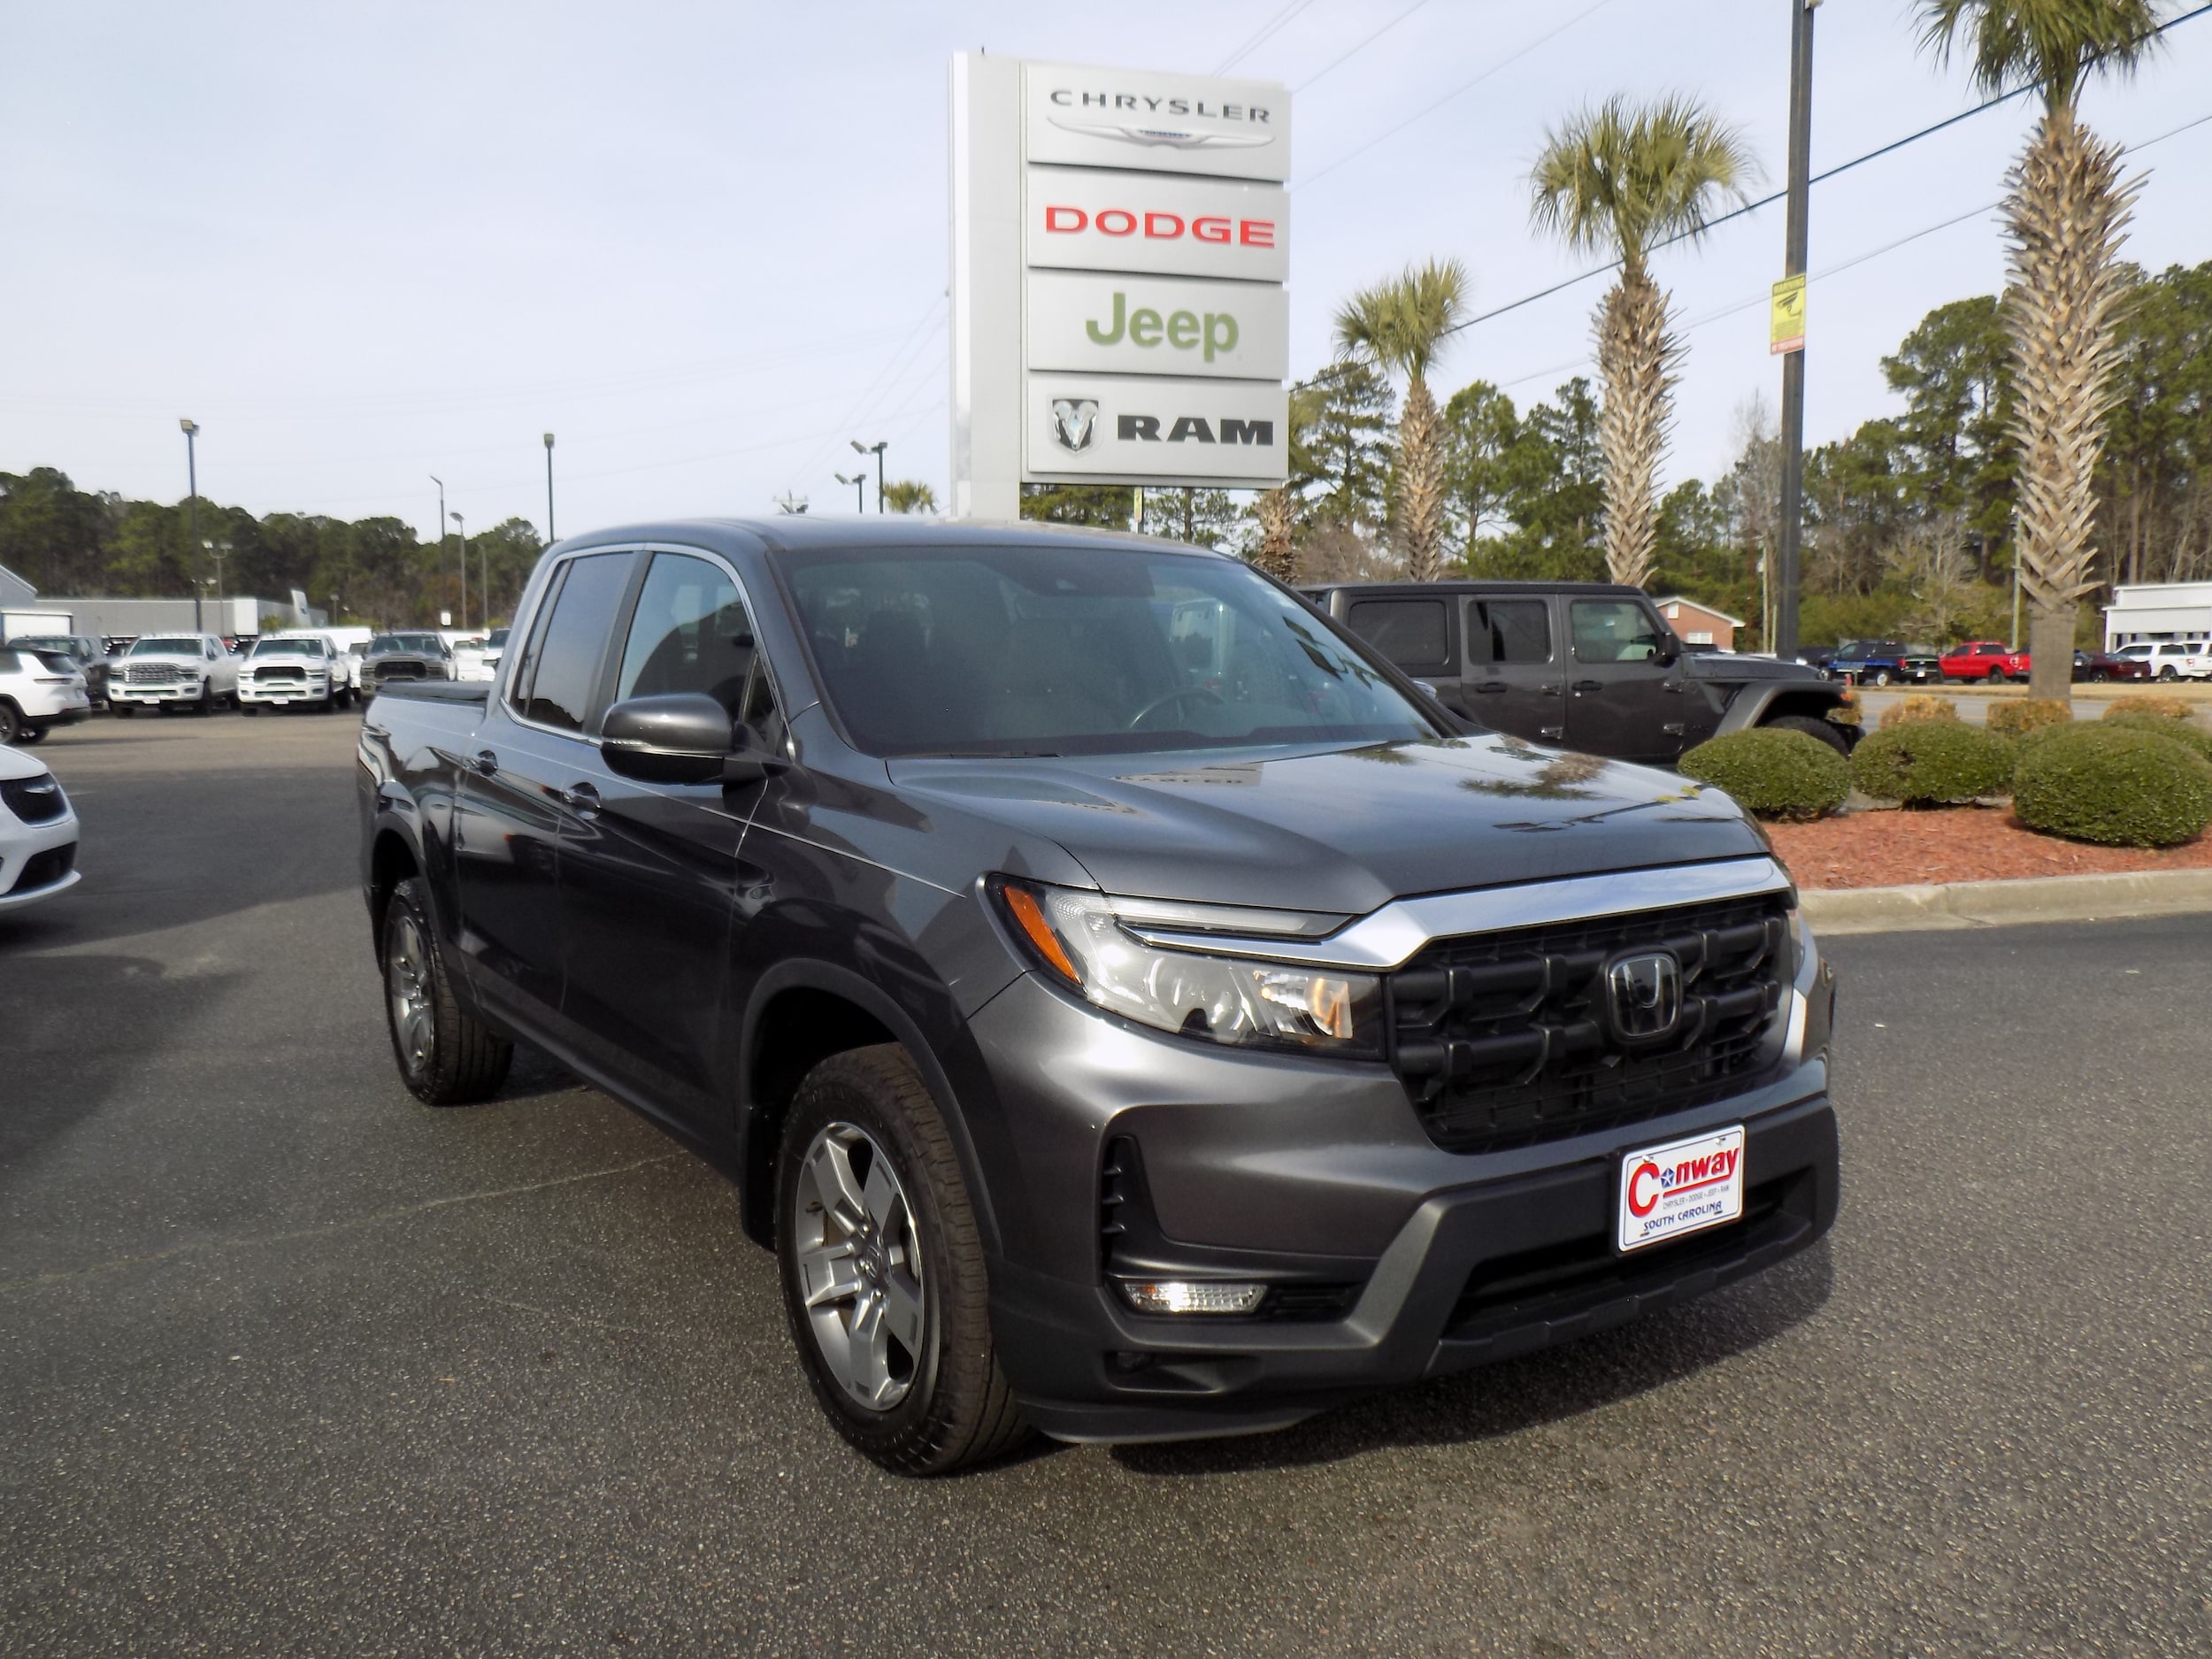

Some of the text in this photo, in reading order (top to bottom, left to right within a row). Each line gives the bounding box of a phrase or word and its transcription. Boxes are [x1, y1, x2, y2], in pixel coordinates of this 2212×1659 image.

[1050, 90, 1271, 123] CHRYSLER
[1046, 207, 1275, 248] DODGE
[1086, 292, 1240, 363] Jeep
[1117, 414, 1274, 446] RAM
[1643, 1200, 1722, 1232] SOUTH CAROLINA
